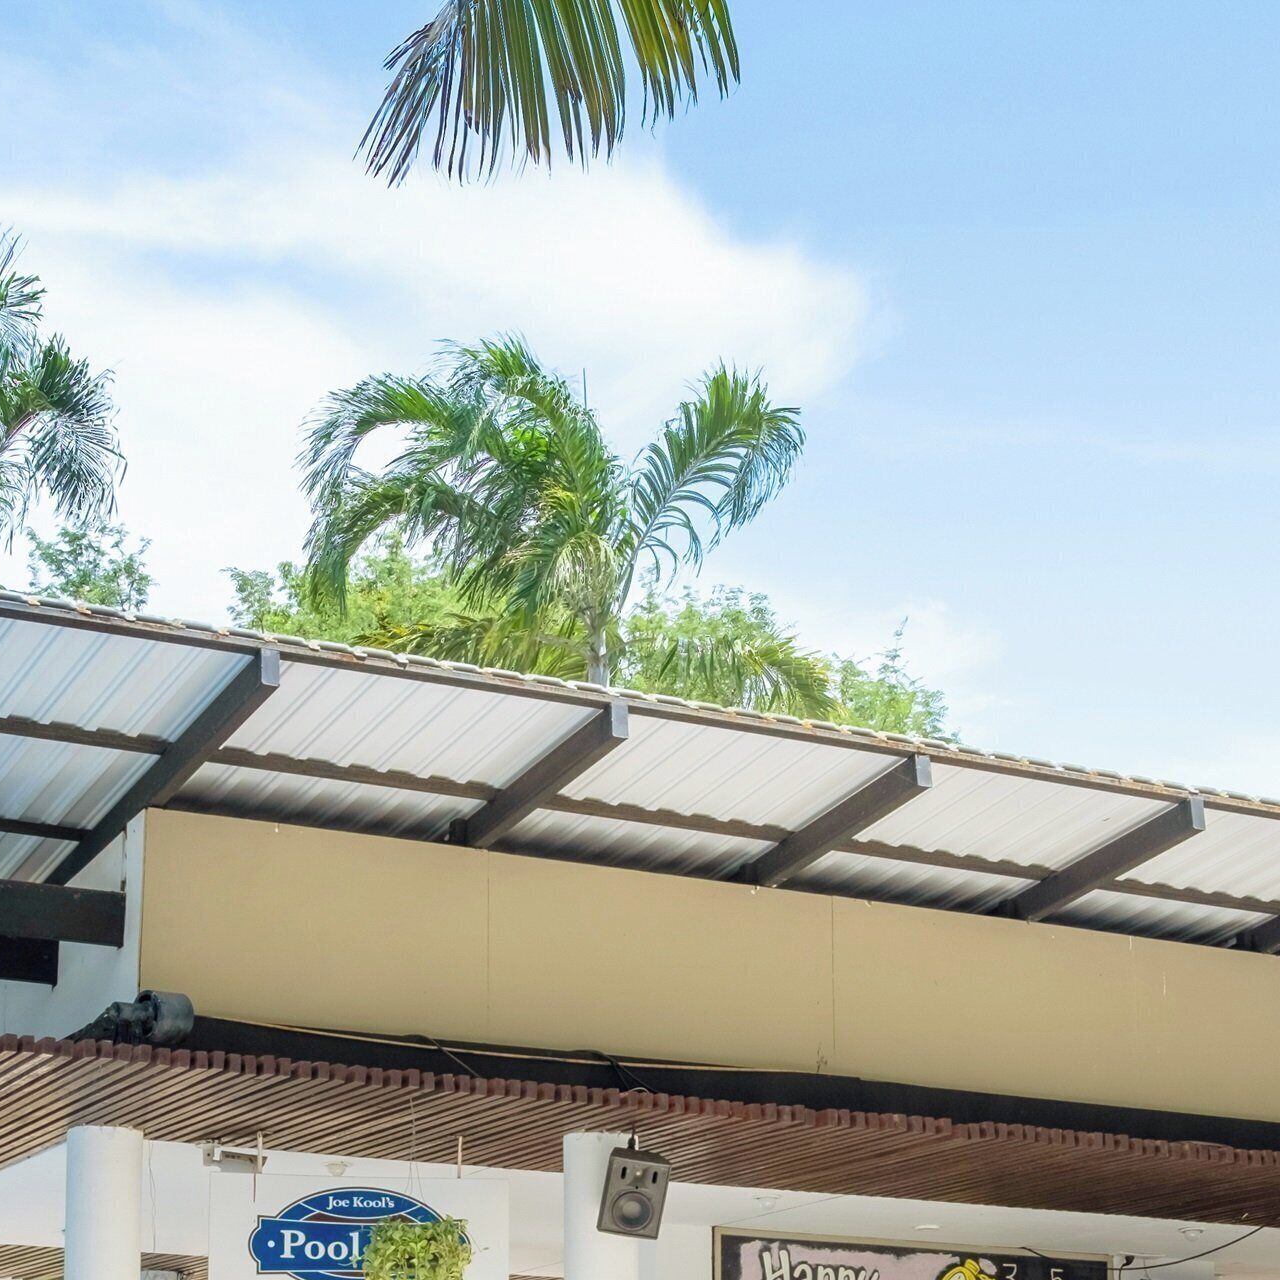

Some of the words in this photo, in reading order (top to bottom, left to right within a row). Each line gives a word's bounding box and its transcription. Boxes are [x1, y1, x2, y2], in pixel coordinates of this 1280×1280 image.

[326, 1196, 350, 1210] Joe
[352, 1196, 395, 1209] Kool's
[279, 1229, 364, 1261] Pool
